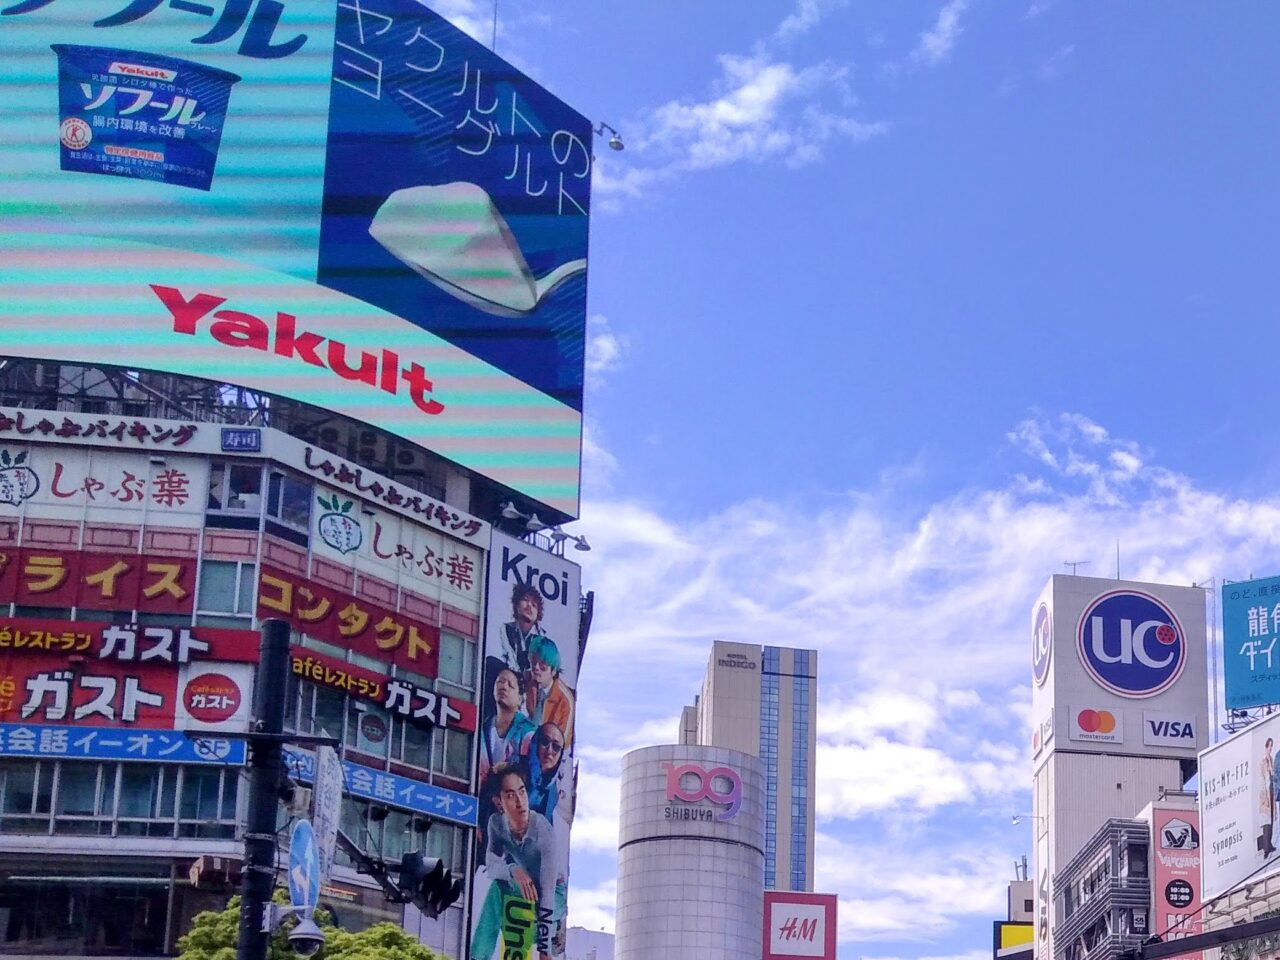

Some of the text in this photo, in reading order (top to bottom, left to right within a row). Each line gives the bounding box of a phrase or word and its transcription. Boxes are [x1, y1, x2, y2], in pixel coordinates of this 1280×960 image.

[116, 64, 169, 81] Yakult
[80, 82, 207, 125] ソフール
[92, 115, 186, 140] 腸内環境を改善
[334, 41, 588, 216] ヨーグルト
[149, 283, 446, 416] Yakult
[51, 462, 190, 508] しゃぶ葉
[305, 446, 483, 537] しゃぶしゃぶバイキング
[0, 553, 188, 600] ライス
[373, 522, 474, 591] しゃぶ葉
[502, 545, 569, 607] Kroi
[259, 572, 432, 660] コンタクト
[99, 623, 209, 663] ガスト
[717, 658, 757, 670] INDIGO
[21, 670, 163, 723] ガスト
[190, 694, 236, 710] ガスト
[292, 656, 461, 727] aféレストラン ガスト
[1078, 732, 1116, 741] mastercard
[1146, 719, 1194, 739] VISA
[661, 761, 744, 822] 109
[1204, 760, 1249, 797] KIS-MY-FT2
[664, 807, 713, 822] SHIBUYA
[1156, 850, 1201, 869] VANGUARD
[1212, 829, 1243, 856] Synopsis
[537, 906, 553, 955] New
[779, 917, 818, 943] H&M
